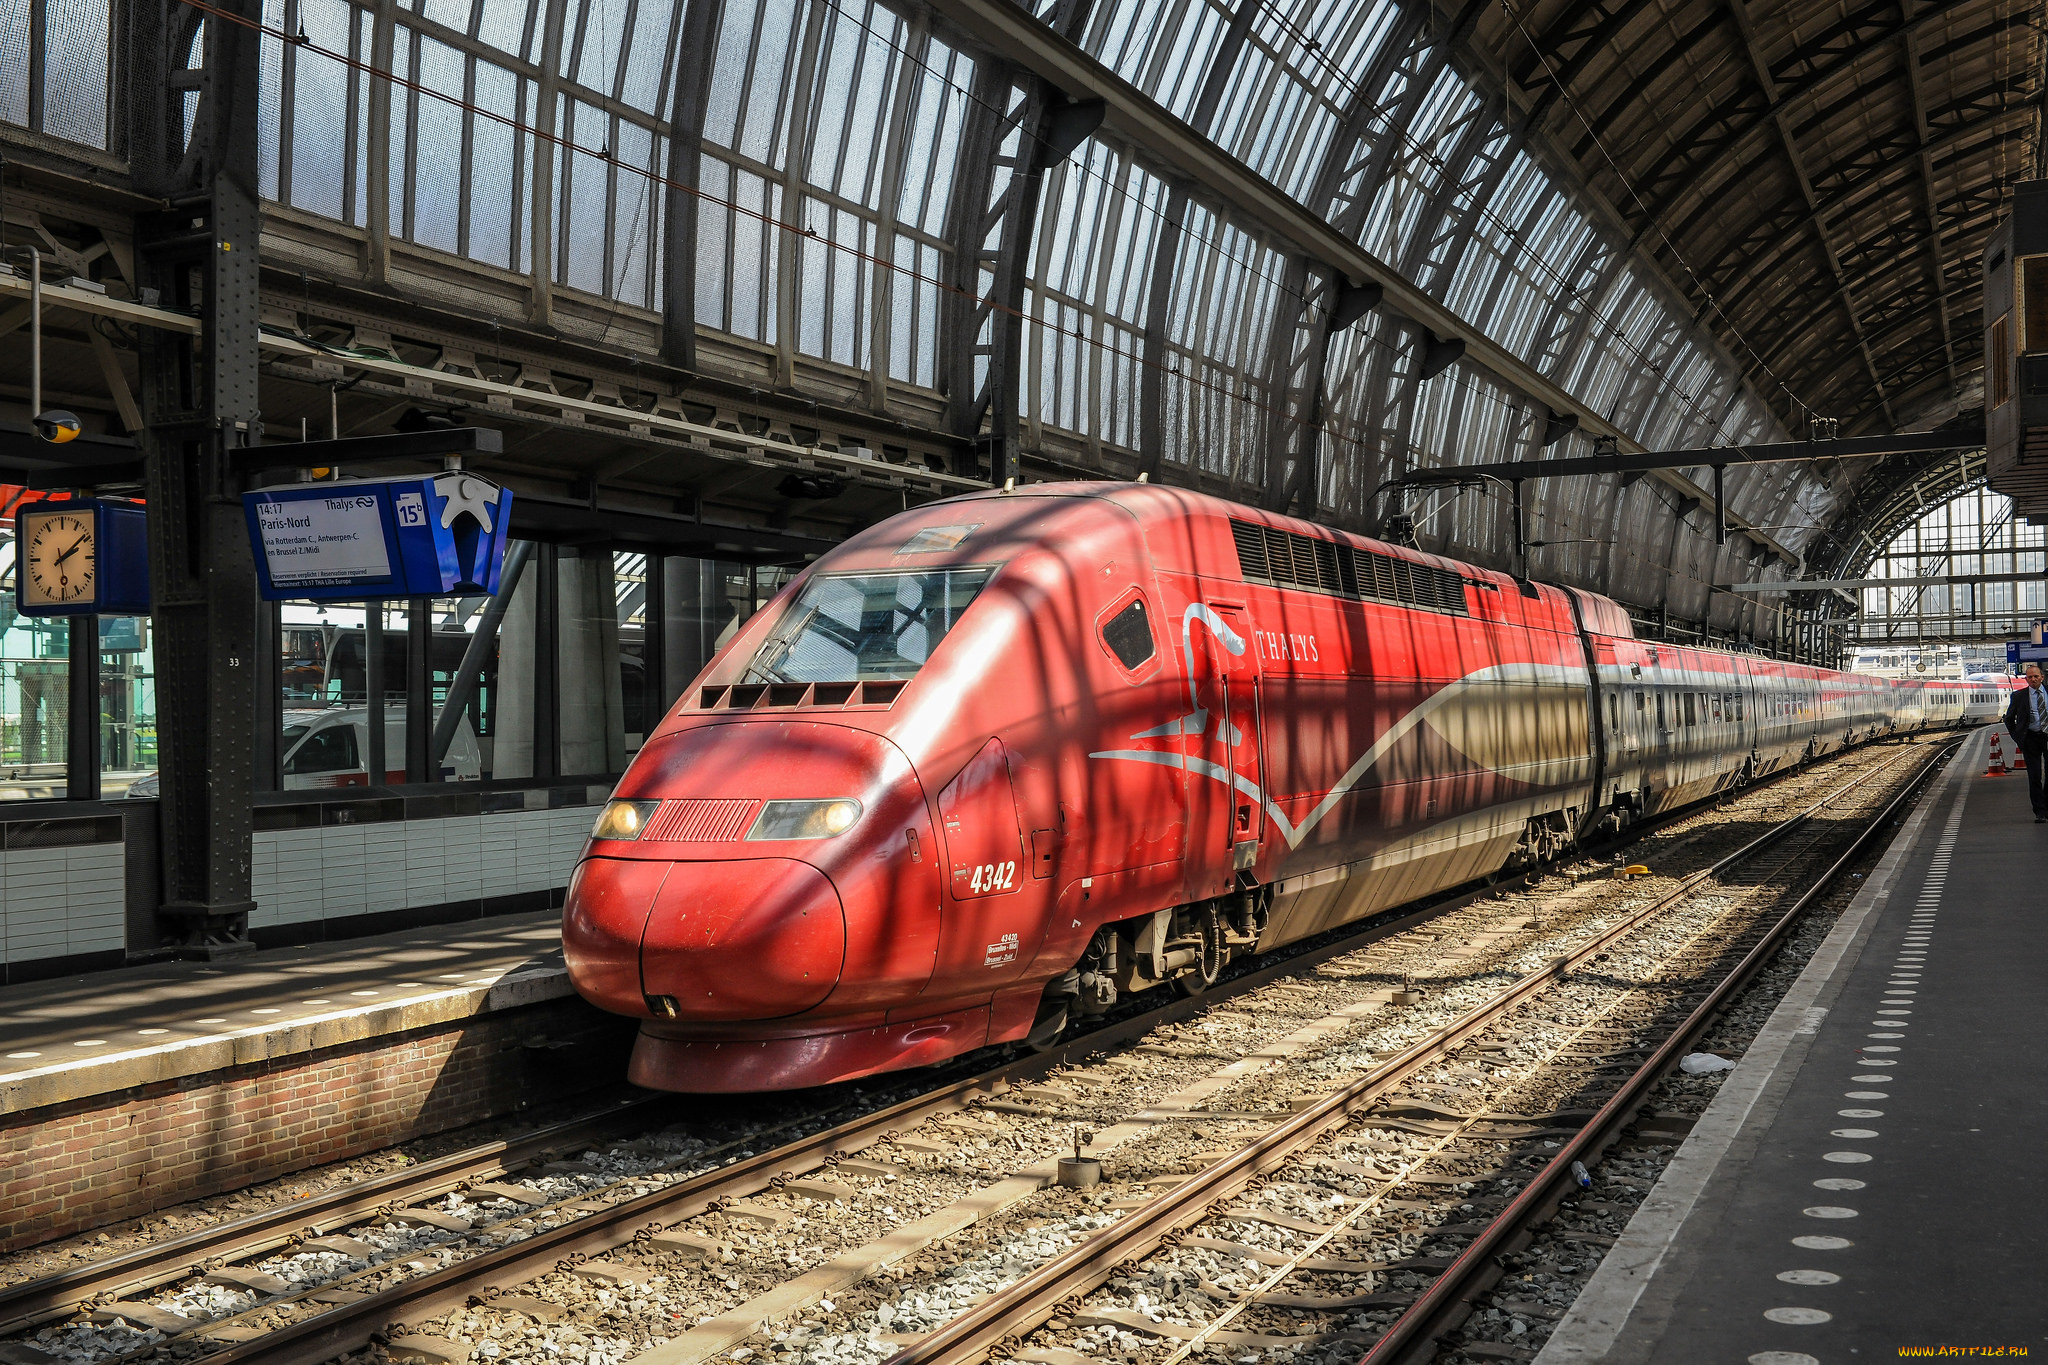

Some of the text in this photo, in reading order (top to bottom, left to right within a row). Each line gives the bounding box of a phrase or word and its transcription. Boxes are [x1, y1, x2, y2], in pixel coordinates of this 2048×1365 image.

[259, 504, 282, 515] 14:17
[325, 498, 354, 512] Thalys
[261, 515, 311, 530] Paris-Nord
[265, 538, 275, 546] via
[275, 536, 307, 546] Rotterdam
[318, 533, 360, 543] Antwerpen-C.
[267, 549, 275, 557] en
[276, 547, 297, 556] Brussel
[297, 571, 317, 579] verplicht
[321, 569, 348, 577] Reservation
[348, 568, 368, 577] required
[335, 578, 352, 586] Europe
[1255, 630, 1319, 662] THALYS
[229, 657, 240, 667] 33
[970, 860, 1015, 894] 4342
[1001, 933, 1018, 943] 43420
